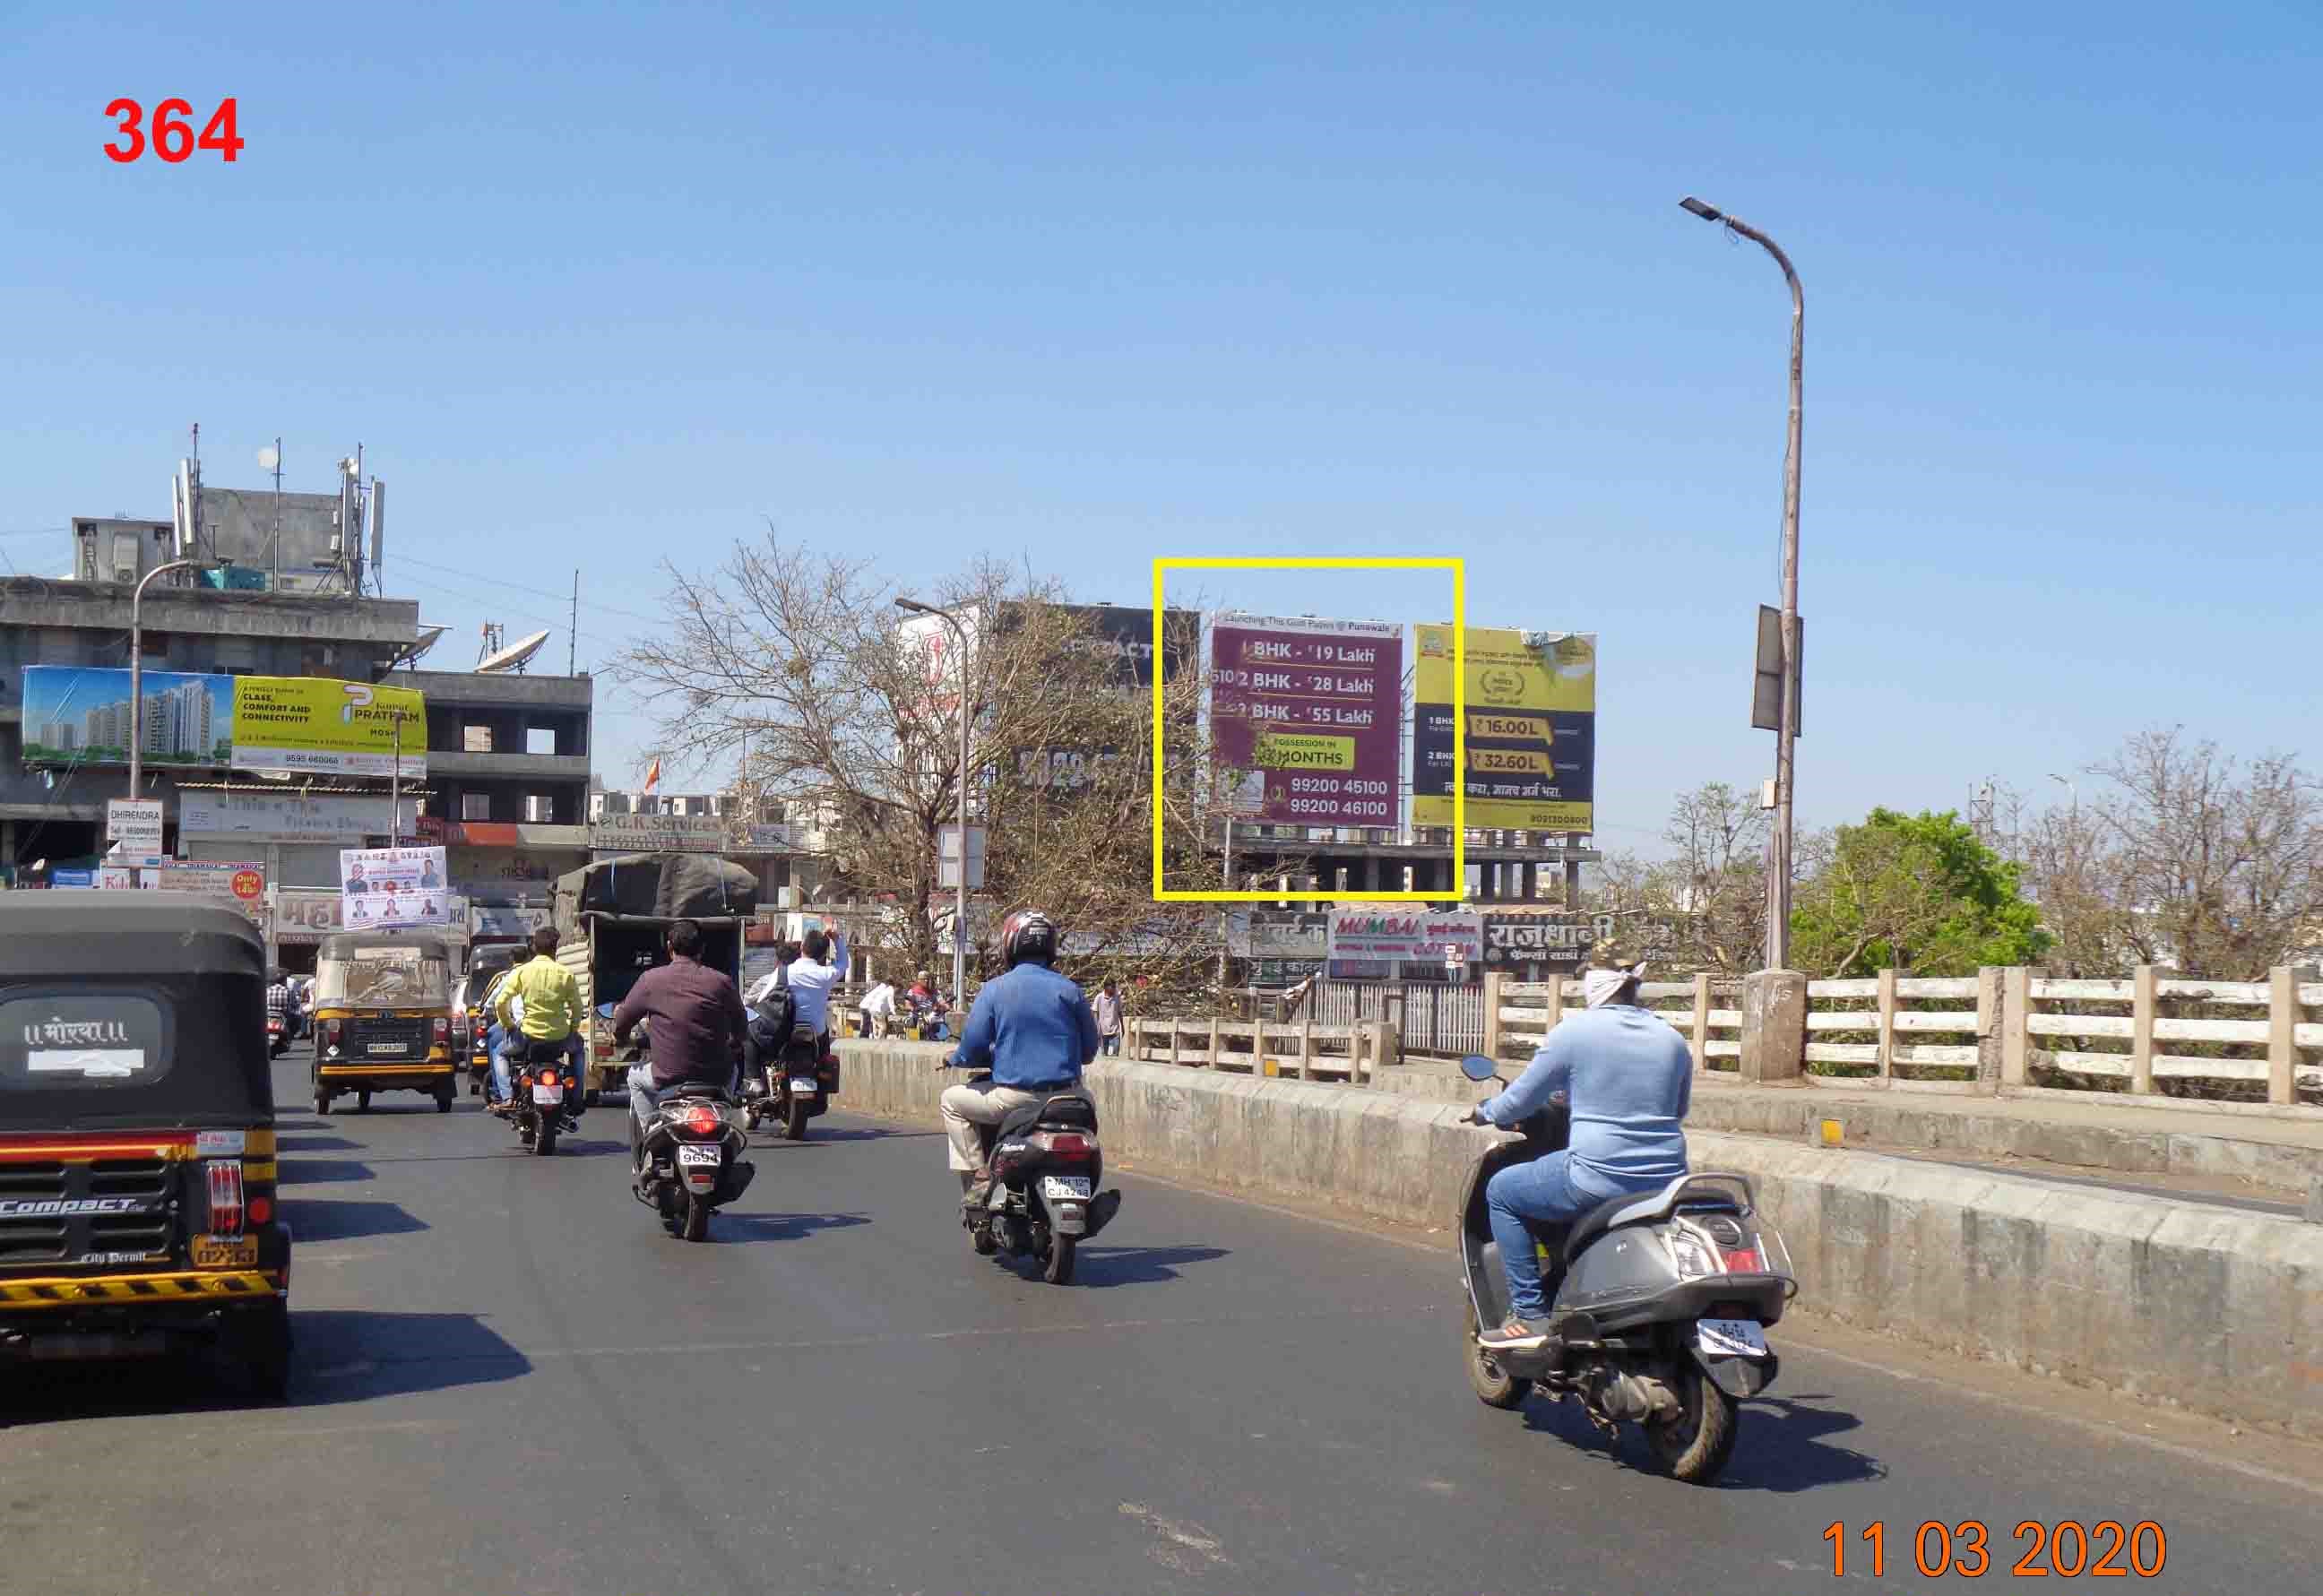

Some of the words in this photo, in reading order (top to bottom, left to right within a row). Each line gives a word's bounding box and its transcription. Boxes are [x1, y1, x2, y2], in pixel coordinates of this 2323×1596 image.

[1254, 641, 1291, 658] BHK
[1239, 671, 1248, 686] 2
[1253, 672, 1291, 689] BHK
[243, 703, 288, 712] COMFORT
[289, 705, 311, 714] AND
[1252, 703, 1290, 720] BHK
[243, 712, 309, 723] CONNECTIVITY
[1291, 777, 1339, 794] 99200
[1343, 779, 1388, 795] 45100
[111, 809, 160, 820] DHIRENDRA
[1290, 798, 1338, 814] 99200
[1343, 800, 1388, 815] 46100
[237, 875, 258, 884] Only
[1335, 916, 1419, 935] MUMBAI
